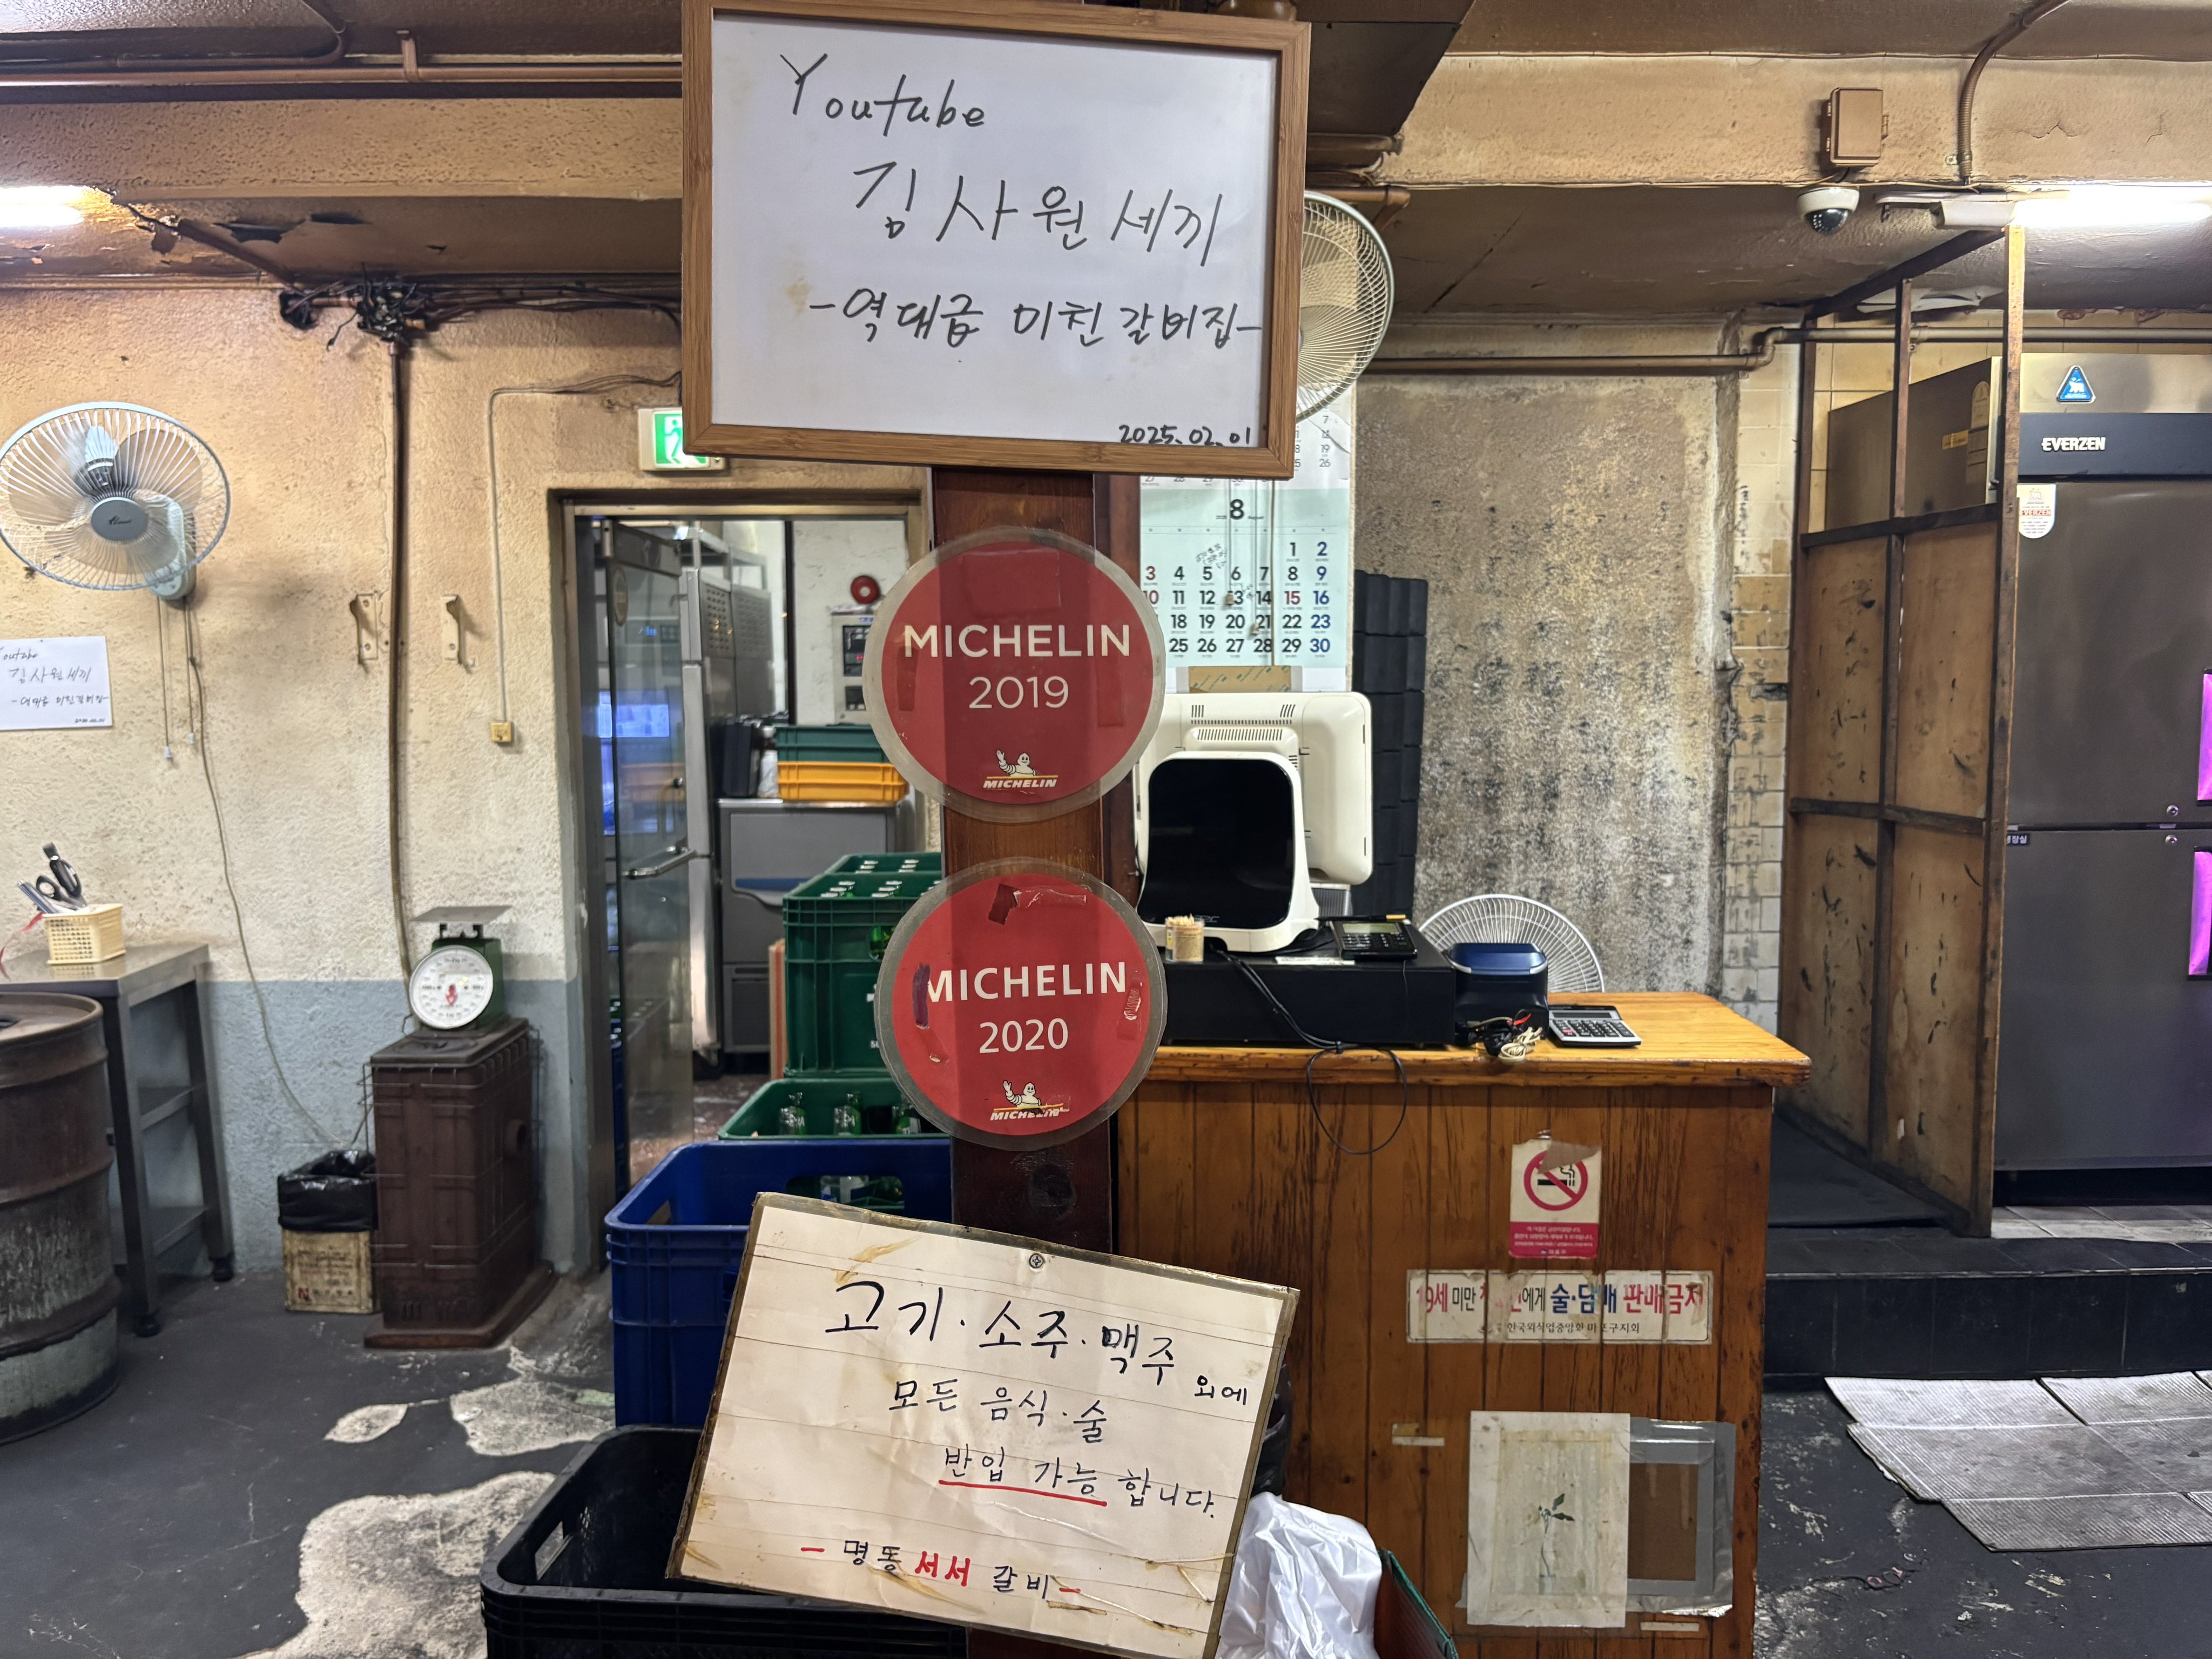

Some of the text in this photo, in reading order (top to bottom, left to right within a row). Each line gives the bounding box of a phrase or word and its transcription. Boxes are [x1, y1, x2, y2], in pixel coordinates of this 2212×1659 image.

[1013, 301, 1104, 347] 미친
[2041, 437, 2106, 451] EVERZEN
[1230, 499, 1244, 520] 8
[1290, 542, 1327, 556] 1 2
[1146, 566, 1327, 581] 3 4 5 6 7 8 9
[1173, 590, 1184, 604] 11
[1199, 590, 1216, 604] 12
[1228, 590, 1243, 604] 3
[1256, 591, 1272, 605] 14
[1284, 591, 1300, 605] 15
[1313, 591, 1329, 605] 16
[1171, 615, 1330, 629] 18 19 20 21 22 23
[905, 624, 1130, 658] MICHELIN
[1169, 638, 1330, 652] 25 26 27 28 29 30
[969, 676, 1069, 709] 2019
[983, 779, 1057, 788] MICHELIN
[927, 961, 1126, 1003] MICHELIN
[979, 1018, 1068, 1054] 2020
[1453, 1287, 1476, 1312] 미만
[889, 1379, 959, 1413] 모든
[1194, 1376, 1248, 1406] 외에
[945, 1444, 1005, 1483] 반입
[1036, 1458, 1098, 1496] 가능
